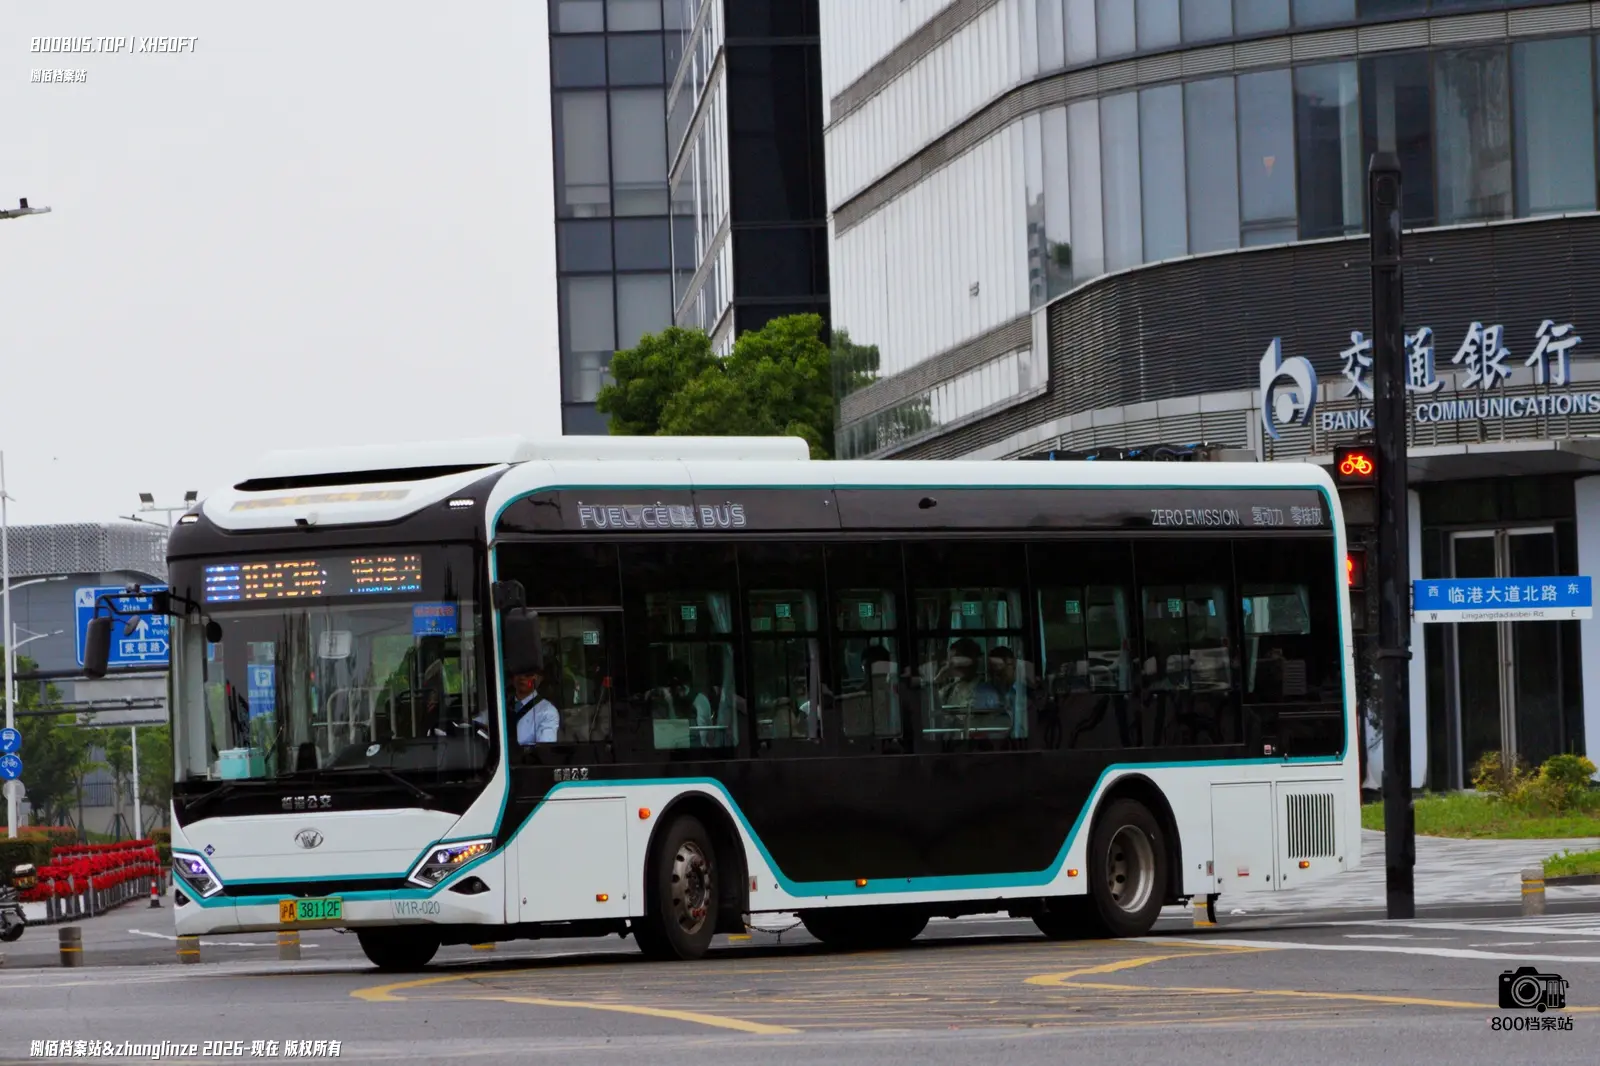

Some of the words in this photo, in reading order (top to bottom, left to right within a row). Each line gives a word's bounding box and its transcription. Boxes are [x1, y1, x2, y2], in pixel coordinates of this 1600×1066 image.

[1322, 408, 1374, 431] BANK
[1416, 392, 1600, 423] COMMUNICATIONS
[578, 504, 638, 529] FUEL
[640, 504, 697, 529] CELL
[700, 504, 746, 527] BUS
[1151, 509, 1184, 526] ZERO
[1185, 509, 1240, 526] EMISSION
[1290, 506, 1324, 525] 零排放
[1428, 586, 1439, 598] 西
[1448, 584, 1558, 605] 临港大道北路
[1568, 583, 1580, 596] 东
[1430, 612, 1438, 621] W
[1571, 609, 1576, 618] E
[300, 900, 340, 918] 38112F
[395, 900, 440, 915] W1R-020
